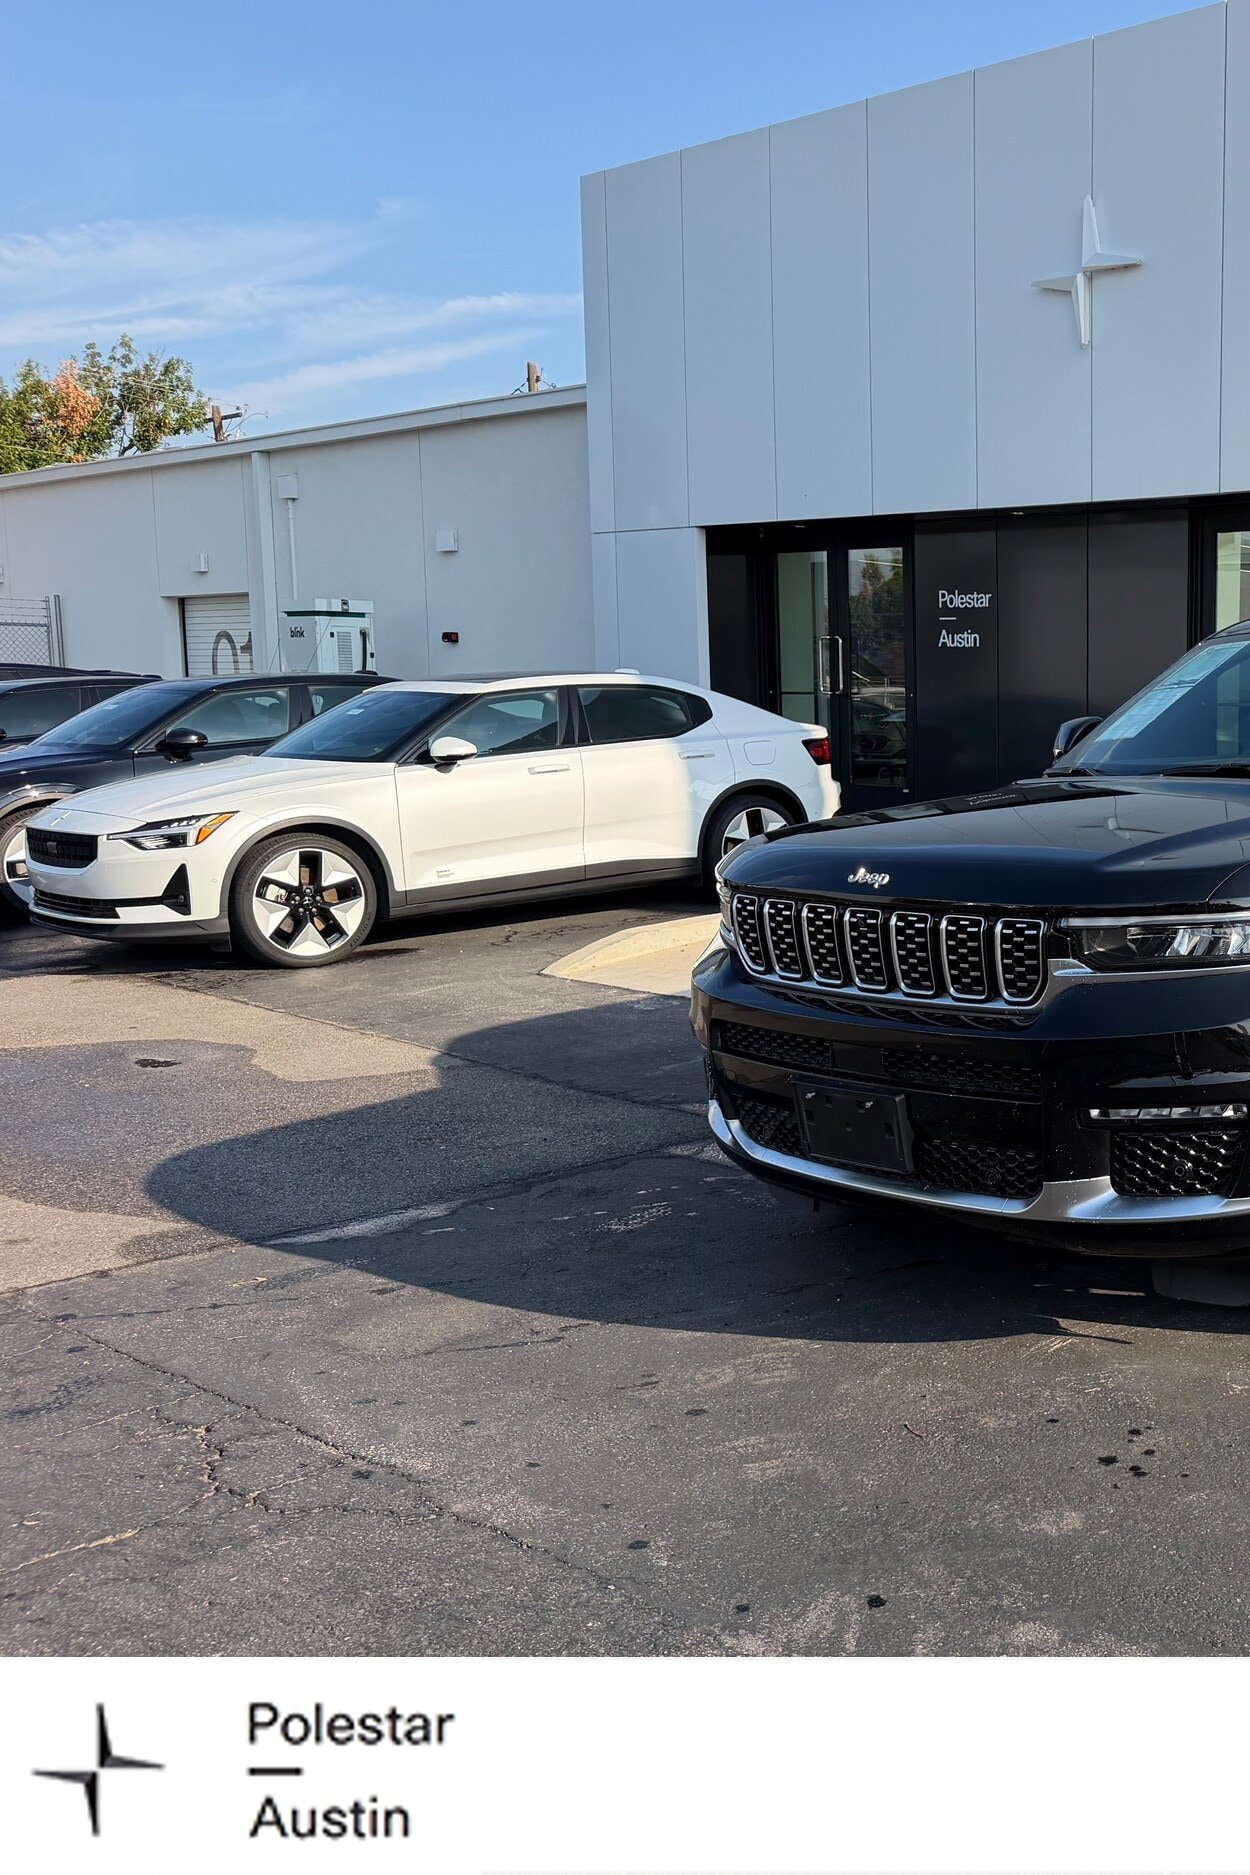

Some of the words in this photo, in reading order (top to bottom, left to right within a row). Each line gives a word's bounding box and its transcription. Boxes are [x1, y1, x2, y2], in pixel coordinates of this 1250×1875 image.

[938, 589, 992, 608] Polestar
[290, 626, 305, 638] blink
[938, 629, 980, 648] Austin
[847, 867, 890, 889] Jeep
